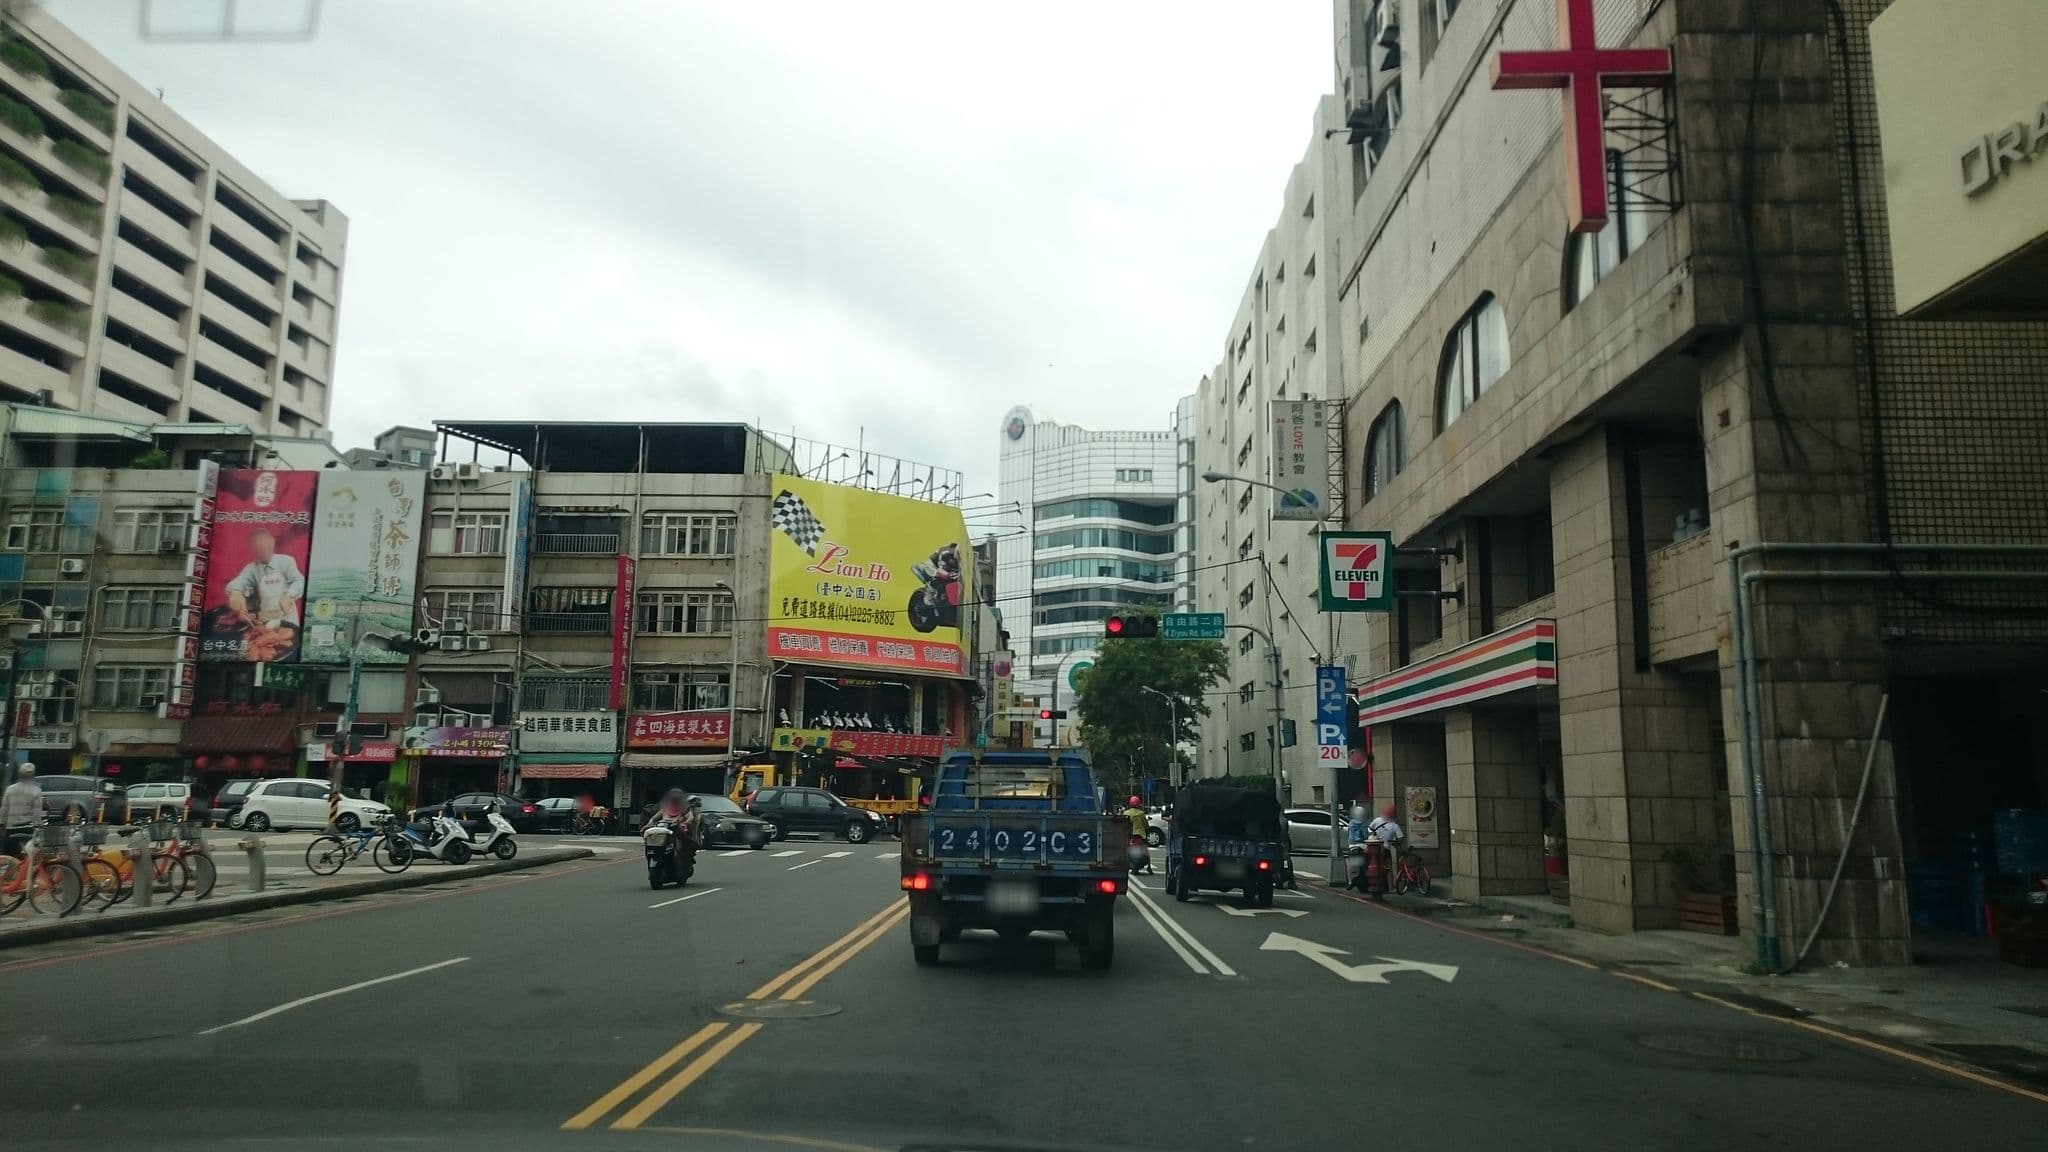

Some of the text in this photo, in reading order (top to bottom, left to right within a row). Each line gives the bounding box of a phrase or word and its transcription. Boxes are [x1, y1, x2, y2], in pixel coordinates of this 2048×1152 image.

[806, 542, 891, 582] Lian Ho
[1166, 616, 1223, 627] 自由路二段
[1320, 678, 1336, 701] P
[524, 716, 612, 733] 越南華僑美食館
[649, 719, 726, 736] 四海豆漿大王
[1320, 723, 1341, 745] P
[1320, 746, 1341, 760] 20
